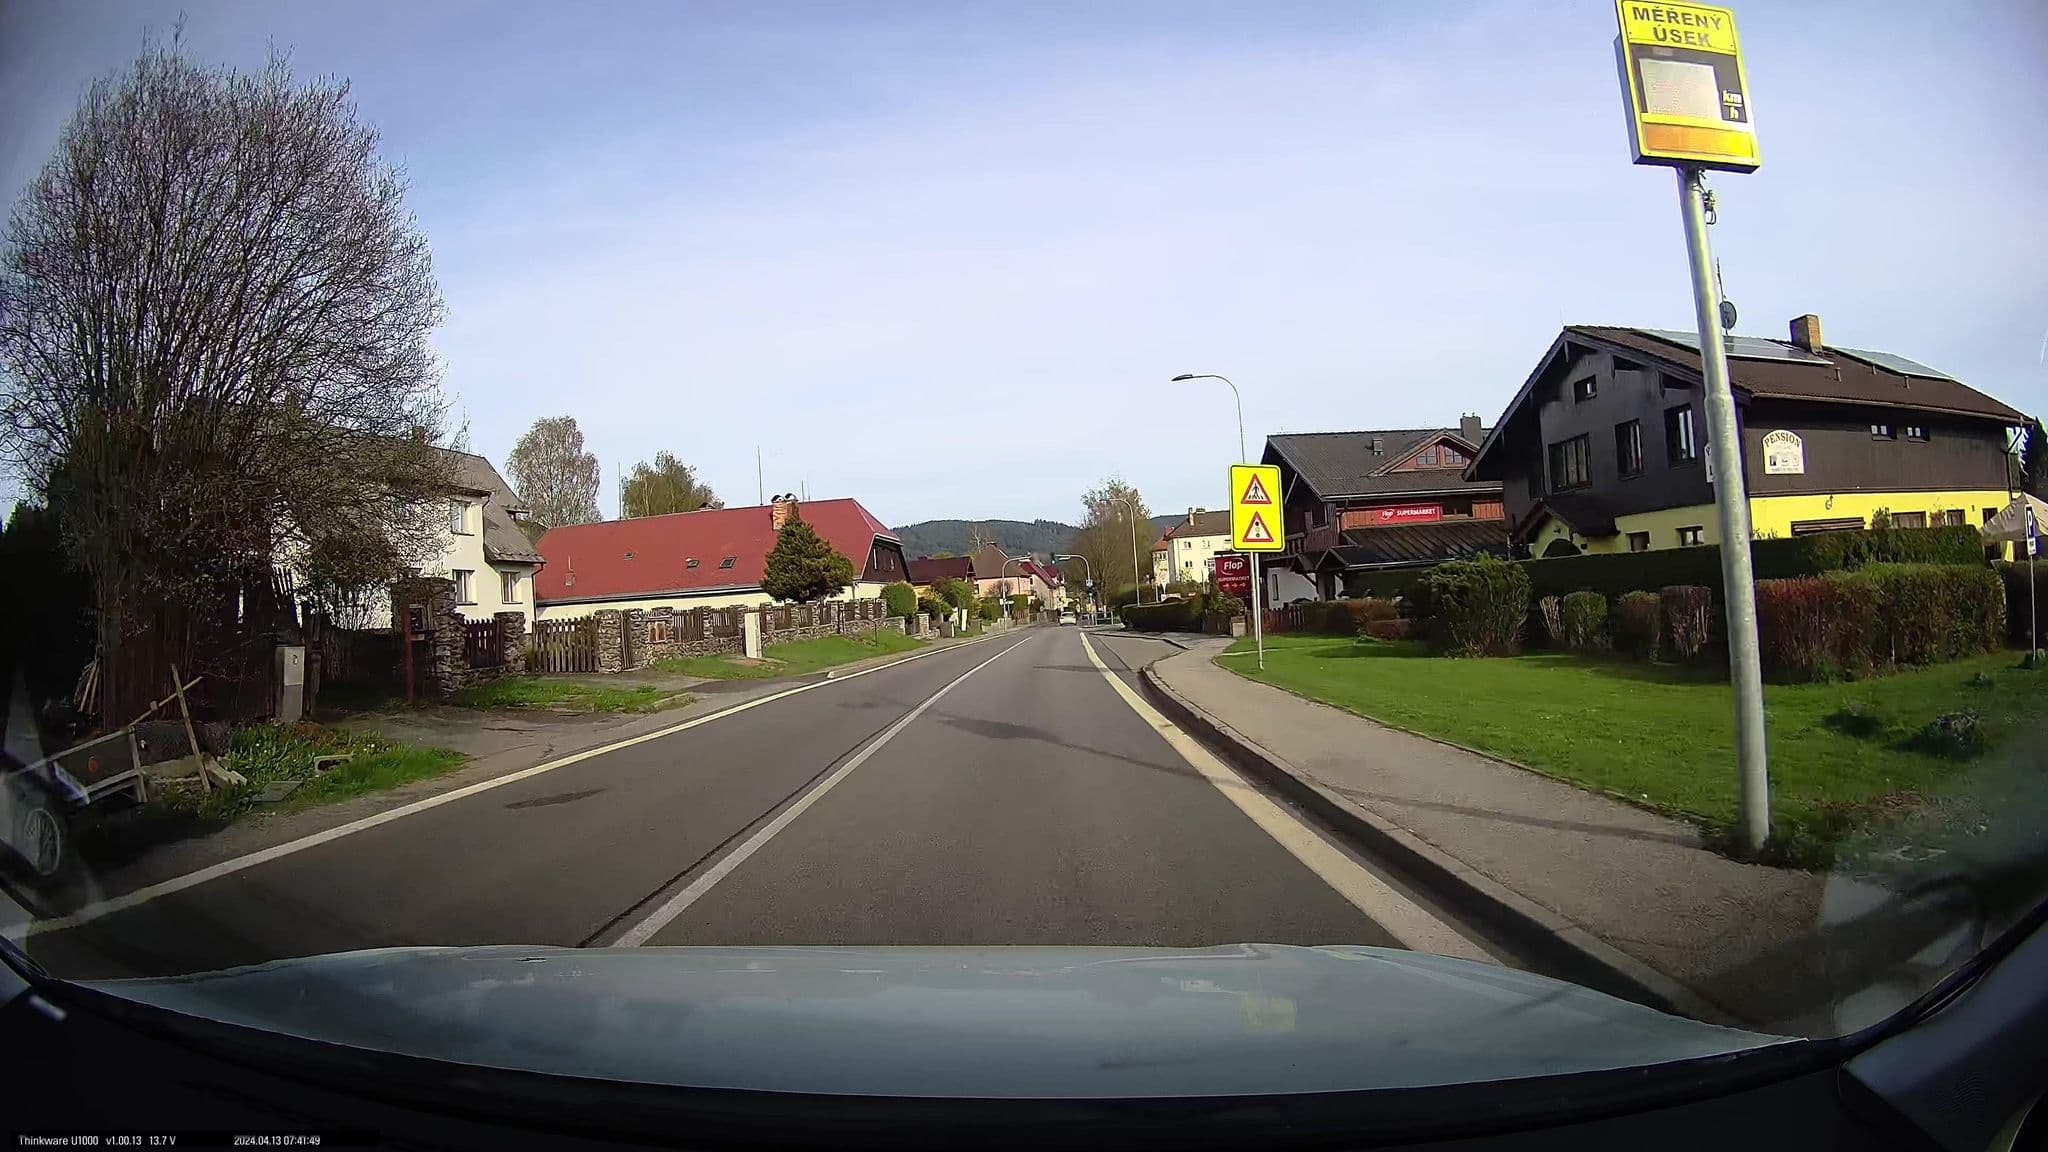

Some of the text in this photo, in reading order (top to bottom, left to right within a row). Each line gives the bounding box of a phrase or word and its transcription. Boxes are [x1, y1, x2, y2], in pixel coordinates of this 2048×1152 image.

[1633, 6, 1722, 30] MĚŘENÝ
[1653, 24, 1712, 47] ÚSEK
[1722, 89, 1742, 104] km
[1729, 107, 1739, 120] h
[1764, 432, 1800, 447] PENSION
[2028, 511, 2032, 535] P
[1223, 560, 1243, 570] Flop
